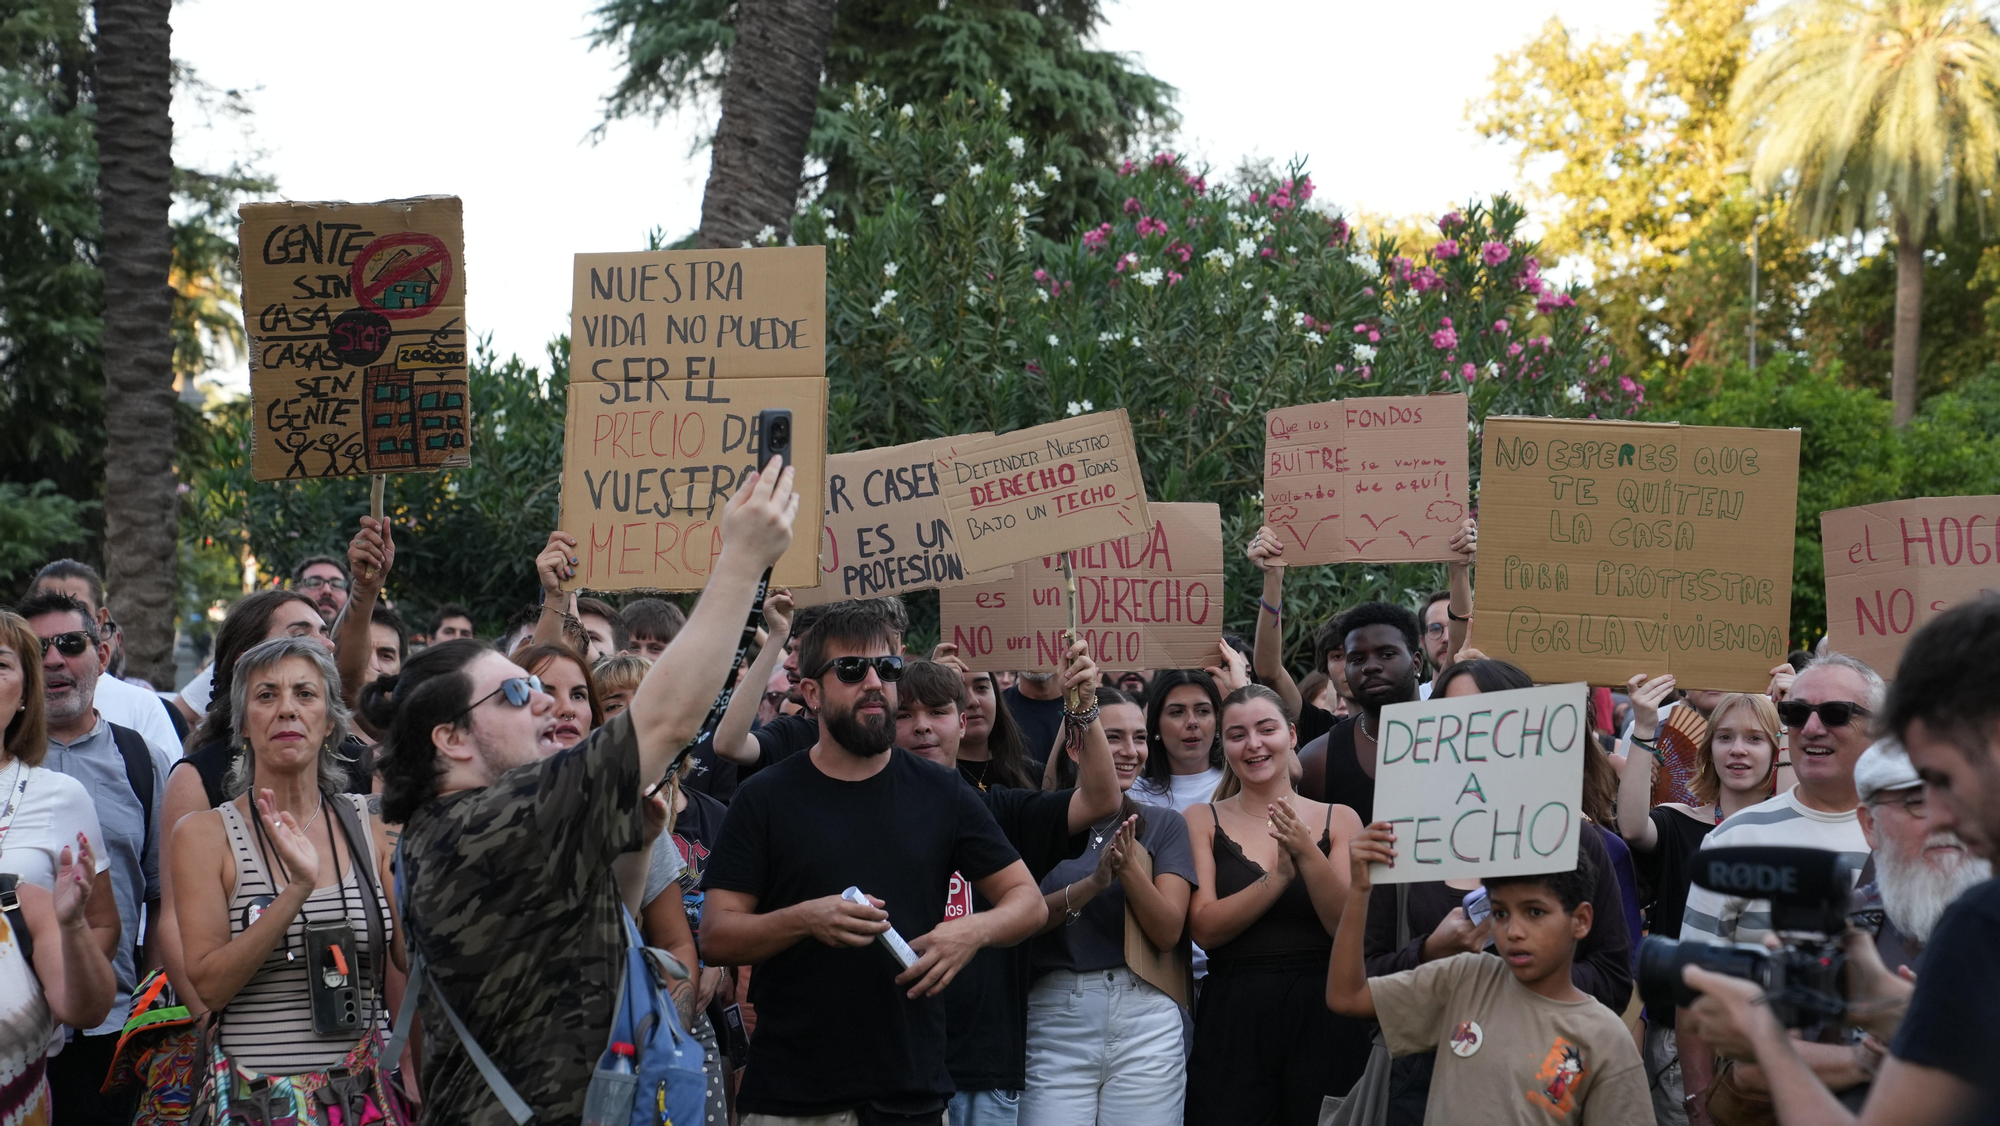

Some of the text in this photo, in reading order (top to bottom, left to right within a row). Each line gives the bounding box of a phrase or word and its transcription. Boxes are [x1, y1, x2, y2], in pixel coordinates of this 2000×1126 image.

[263, 221, 376, 266] GENTE
[293, 274, 351, 299] SIN
[591, 260, 743, 303] NUESTRA
[260, 302, 332, 332] CASA
[582, 312, 811, 350] VIDA NO PUEDE
[263, 342, 344, 371] CASAS
[296, 371, 356, 398] SIN
[592, 356, 731, 405] SER EL
[267, 398, 359, 431] GENTE
[593, 410, 706, 459] PRECIO
[1270, 406, 1422, 440] Que los FONDOS
[955, 434, 1109, 485] DEFENDER NUESTRO
[1361, 461, 1380, 471] se
[1395, 459, 1447, 470] vayan
[1496, 437, 1760, 476] NO ESPERES QUE
[970, 459, 1119, 506] DERECHO TODAS
[1271, 485, 1336, 502] volando
[1356, 480, 1383, 494] de
[1549, 475, 1598, 505] TE
[967, 484, 1117, 541] BAJO UN TECHO
[1550, 510, 1694, 550] LA CASA
[857, 523, 896, 558] ES
[1849, 514, 2000, 566] el HOG
[975, 576, 1210, 625] es un DERECHO
[1504, 555, 1773, 605] PARA PROTESTAR
[1506, 606, 1570, 654] POR
[1579, 614, 1625, 655] LA
[1856, 588, 1914, 636] NO
[954, 625, 994, 658] NO
[1037, 629, 1140, 666] NEOCIO
[1384, 704, 1578, 765] DERECHO
[1456, 772, 1487, 805] A
[1388, 801, 1570, 869] TECHO
